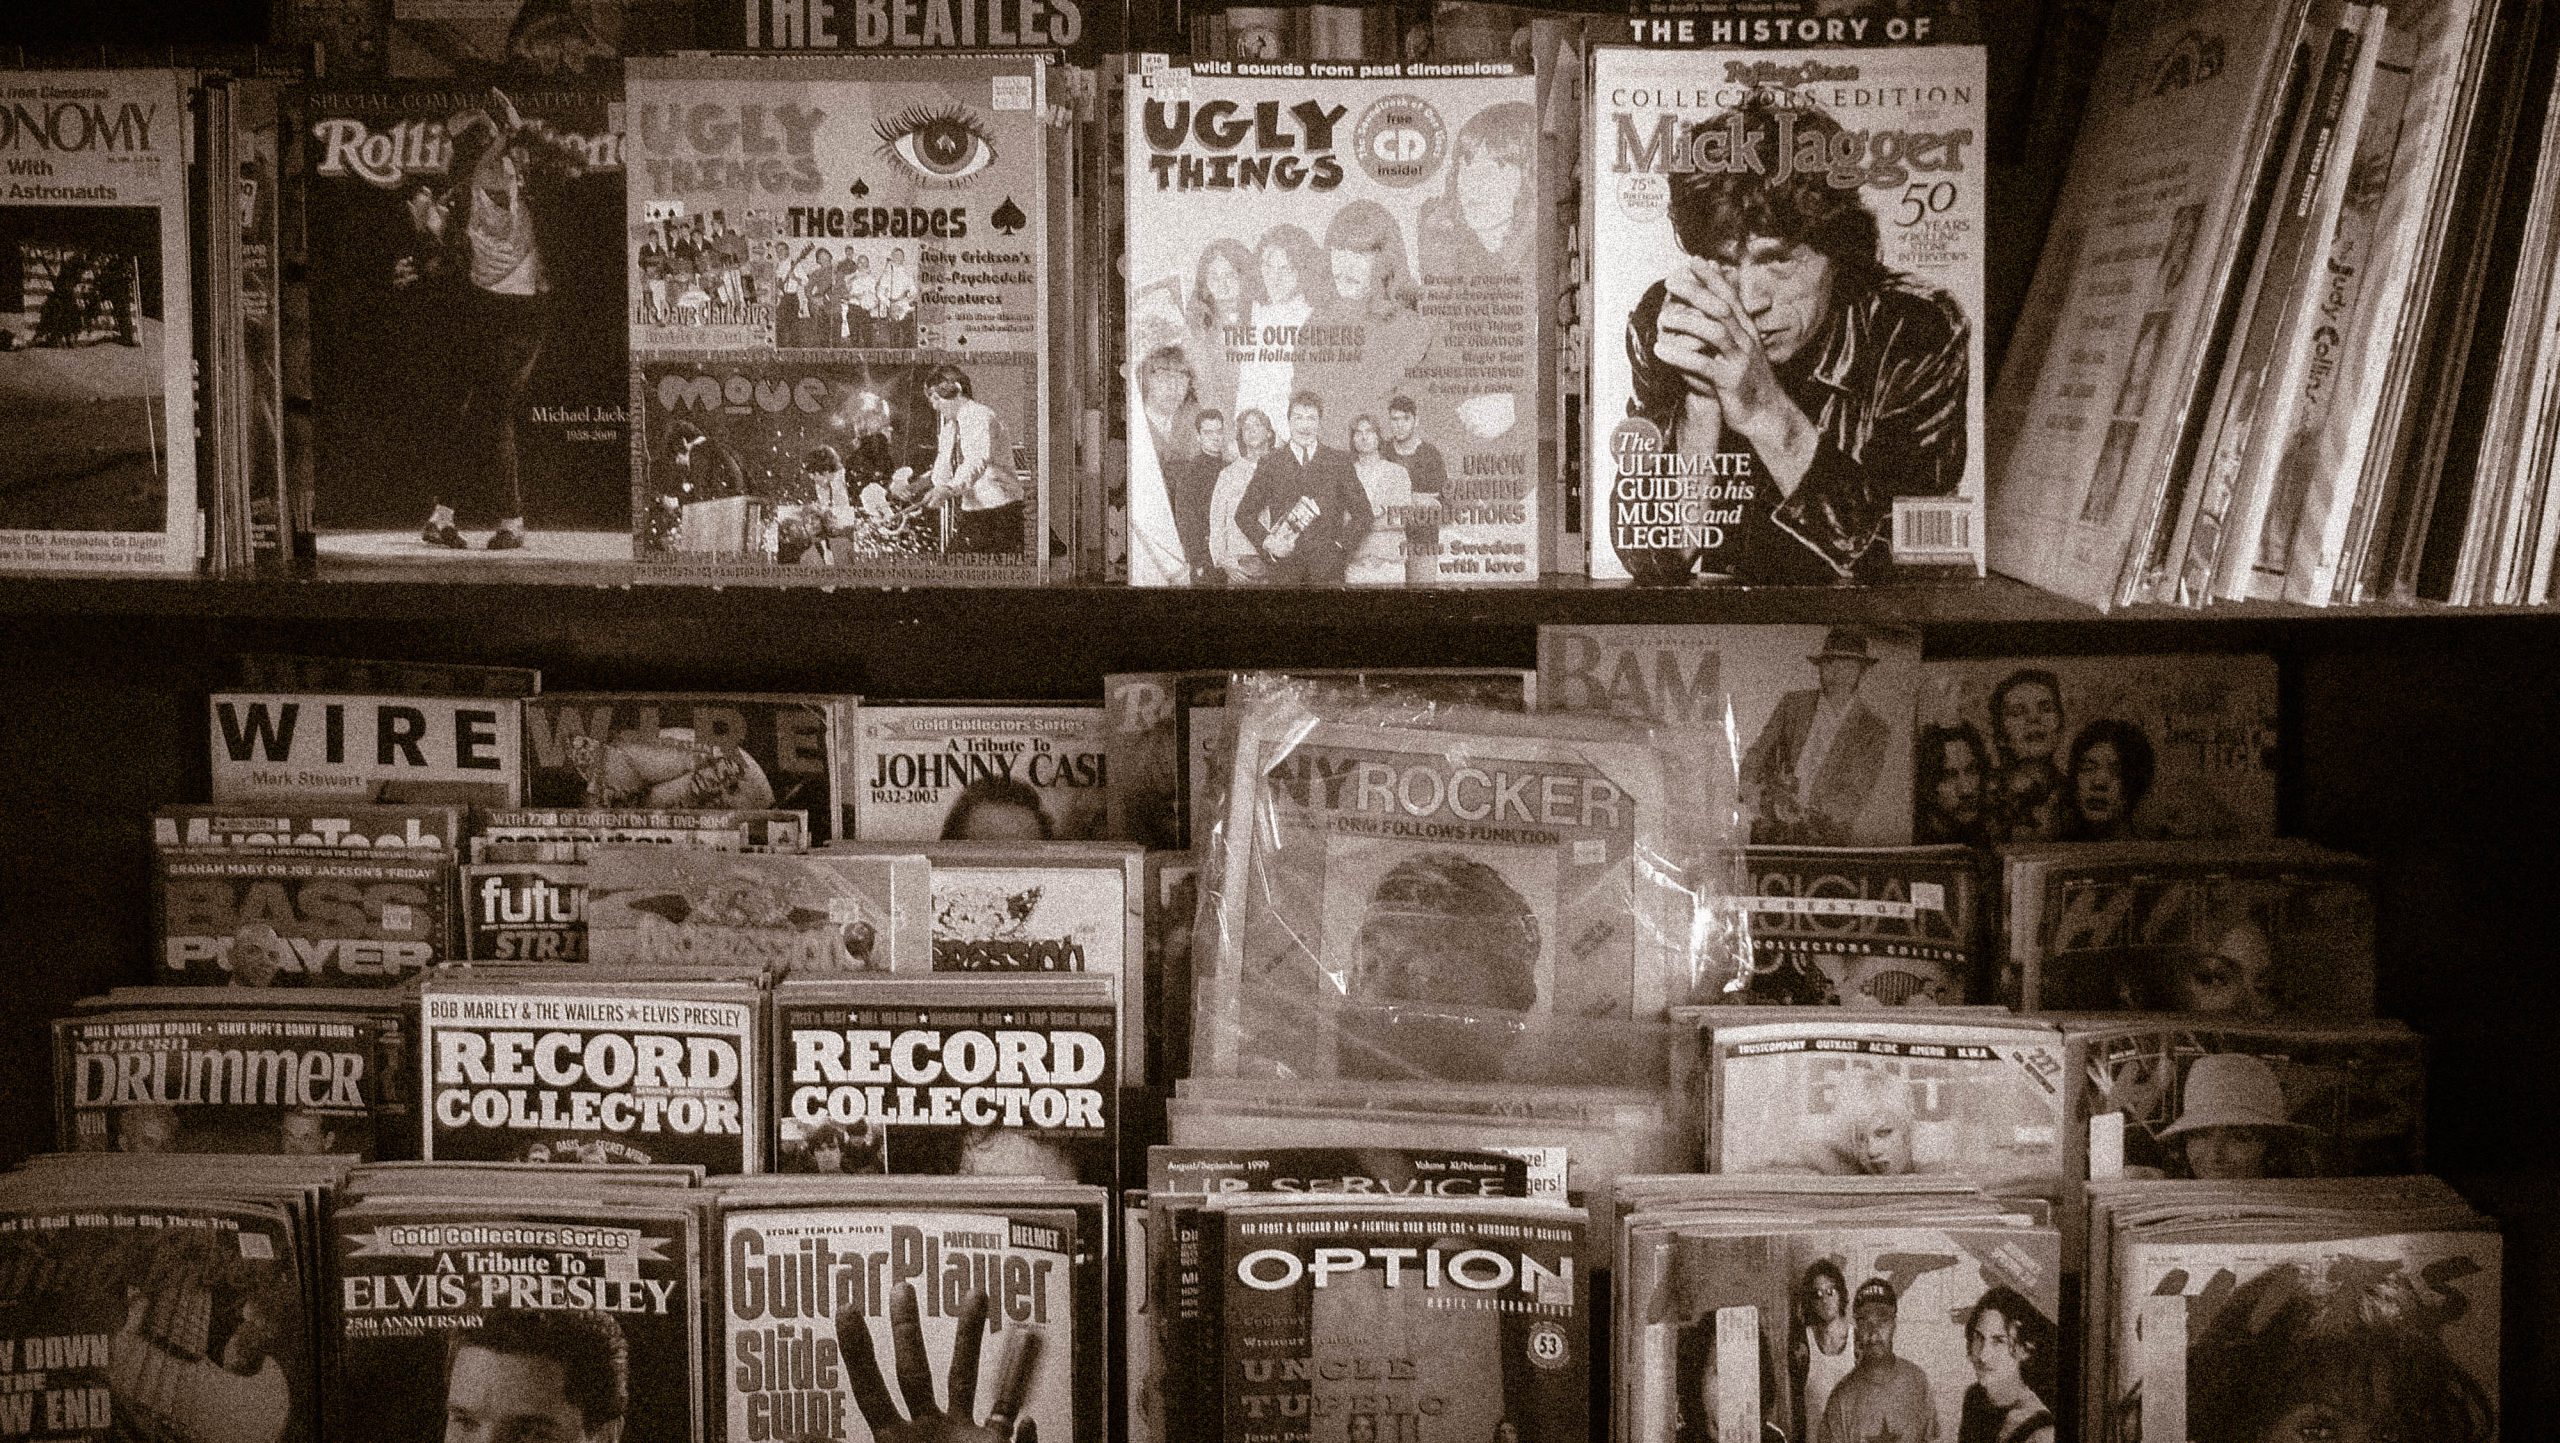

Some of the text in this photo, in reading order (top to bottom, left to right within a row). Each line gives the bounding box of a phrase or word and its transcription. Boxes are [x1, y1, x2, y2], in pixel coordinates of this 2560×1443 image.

[746, 0, 1082, 47] THE BEATLES
[1631, 18, 1931, 42] THE HISTORY OF
[1193, 60, 1515, 79] wild sounds from past dimensions
[1611, 84, 1972, 108] COLLECTORS EDITION
[640, 103, 827, 155] UGLY
[1143, 100, 1348, 153] UGLY
[311, 117, 454, 190] Rolli
[1372, 129, 1427, 161] CD
[1610, 112, 1765, 177] Mick
[1770, 112, 1973, 191] Jagger
[7, 158, 53, 176] With
[644, 156, 824, 195] THINGS
[1149, 153, 1345, 193] THINGS
[9, 182, 118, 199] Astronauts
[1894, 181, 1958, 228] 50
[1923, 220, 1971, 232] YEARS
[920, 248, 1031, 267] Roky Erickson's
[920, 291, 1002, 305] Adventures
[660, 303, 696, 326] Dave
[699, 303, 734, 326] Clark
[734, 303, 770, 326] Five
[1222, 326, 1367, 347] THE OUTSIDERS
[1225, 349, 1256, 363] from
[1258, 348, 1304, 363] Holland
[2303, 323, 2342, 406] Collins
[531, 405, 589, 423] Michael
[1617, 432, 1656, 454] The
[1464, 454, 1526, 476] UNION
[1616, 454, 1752, 477] ULTIMATE
[1616, 478, 1755, 502] GUIDE to his
[1386, 505, 1526, 526] PRODUCTIONS
[1616, 503, 1743, 527] MUSIC and
[1449, 540, 1526, 556] Sweden
[1616, 527, 1725, 550] LEGEND
[1439, 558, 1526, 574] with love
[1537, 632, 1721, 722] BAM
[214, 701, 502, 771] WIRE
[912, 717, 1086, 733] Gold Collectors Series
[947, 738, 1051, 753] A Tribute To
[251, 770, 363, 790] Mark Stewart
[870, 752, 1019, 790] JOHNNY
[871, 790, 939, 804] 1932-2003
[1356, 763, 1621, 830] ROCKER
[493, 814, 527, 827] WITH
[560, 814, 577, 828] OF
[578, 815, 630, 829] CONTENT
[630, 815, 649, 829] ON
[650, 815, 674, 829] THE
[1381, 818, 1463, 839] FOLLOWS
[1469, 829, 1560, 846] FUNKTION
[266, 865, 287, 877] ON
[289, 866, 312, 878] JOE
[315, 867, 382, 880] JACKSON'S
[164, 881, 432, 943] BASS
[1752, 940, 1967, 963] COLLECTORS EDITION
[431, 1001, 741, 1028] BOB MARLEY & THE WAILERS ELVIS PRESLEY
[164, 1021, 201, 1036] UPDATE
[319, 1024, 354, 1038] BROWN
[1815, 1039, 1859, 1051] OUTKAST
[1869, 1042, 1899, 1054] AC/DC
[436, 1030, 739, 1088] RECORD
[792, 1030, 1106, 1084] RECORD
[2027, 1046, 2062, 1079] 227
[435, 1088, 741, 1134] COLLECTOR
[791, 1086, 1106, 1128] COLLECTOR
[1167, 1160, 1270, 1173] August/September 1999
[1415, 1161, 1446, 1171] Volume
[74, 1214, 109, 1228] With
[766, 1226, 885, 1237] STONE TEMPLE PILOTS
[1258, 1222, 1284, 1235] FROST
[1295, 1222, 1332, 1234] CHICANO
[1361, 1221, 1400, 1234] FIGHTING
[1402, 1222, 1424, 1234] OVER
[1426, 1222, 1448, 1235] USED
[1477, 1224, 1520, 1238] HUNDREDS
[1523, 1227, 1534, 1239] OF
[1536, 1228, 1573, 1242] REVIEWS
[391, 1228, 629, 1250] Gold Collectors Series
[942, 1231, 1001, 1250] PAVEMENT
[1011, 1225, 1060, 1251] HELMET
[435, 1252, 587, 1276] A Tribute To
[730, 1224, 1054, 1335] Guitar Player
[1236, 1247, 1575, 1306] OPTION
[343, 1275, 677, 1315] ELVIS PRESLEY
[1427, 1296, 1466, 1310] MUSIC
[345, 1314, 485, 1330] 25th ANNIVERSARY
[24, 1334, 108, 1370] DOWN
[1539, 1336, 1557, 1356] 53
[735, 1327, 839, 1392] Slide
[1241, 1356, 1417, 1382] UNCLE
[46, 1388, 111, 1430] END
[748, 1391, 846, 1443] GUIDE
[1241, 1393, 1444, 1419] TUPELO
